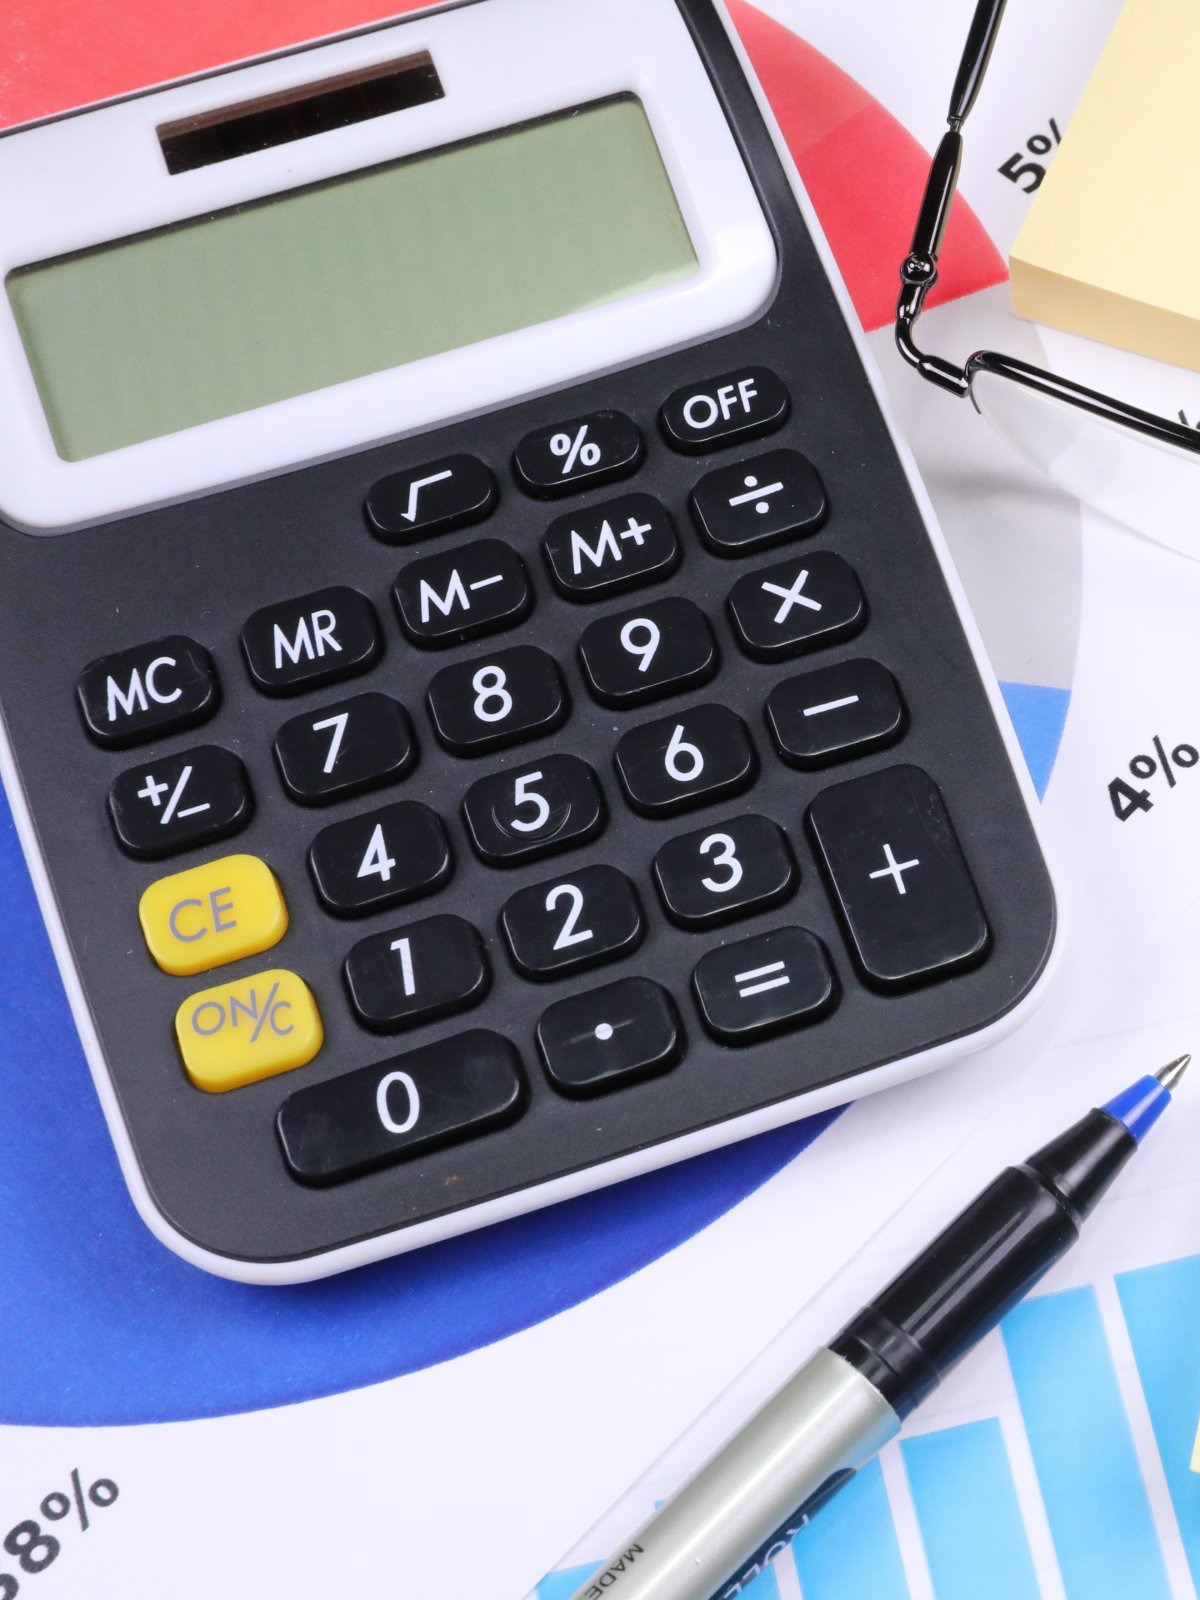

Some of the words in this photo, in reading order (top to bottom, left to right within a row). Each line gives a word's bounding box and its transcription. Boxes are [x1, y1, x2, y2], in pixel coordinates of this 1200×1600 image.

[683, 378, 758, 429] OFF
[549, 424, 601, 474] %
[570, 517, 652, 575] M+
[273, 609, 343, 669] MR
[620, 618, 661, 672] 9
[106, 656, 182, 722] MC
[472, 665, 513, 722] 8
[312, 712, 349, 774] 7
[664, 724, 704, 782] 6
[510, 771, 550, 832] 5
[1107, 735, 1200, 822] 4%
[356, 823, 396, 882] 4
[699, 833, 743, 893] 3
[168, 886, 237, 943] CE
[545, 884, 594, 951] 2
[390, 937, 416, 996] 1
[191, 981, 294, 1043] ON/C
[376, 1071, 420, 1134] 0
[584, 1543, 644, 1600] MADE
